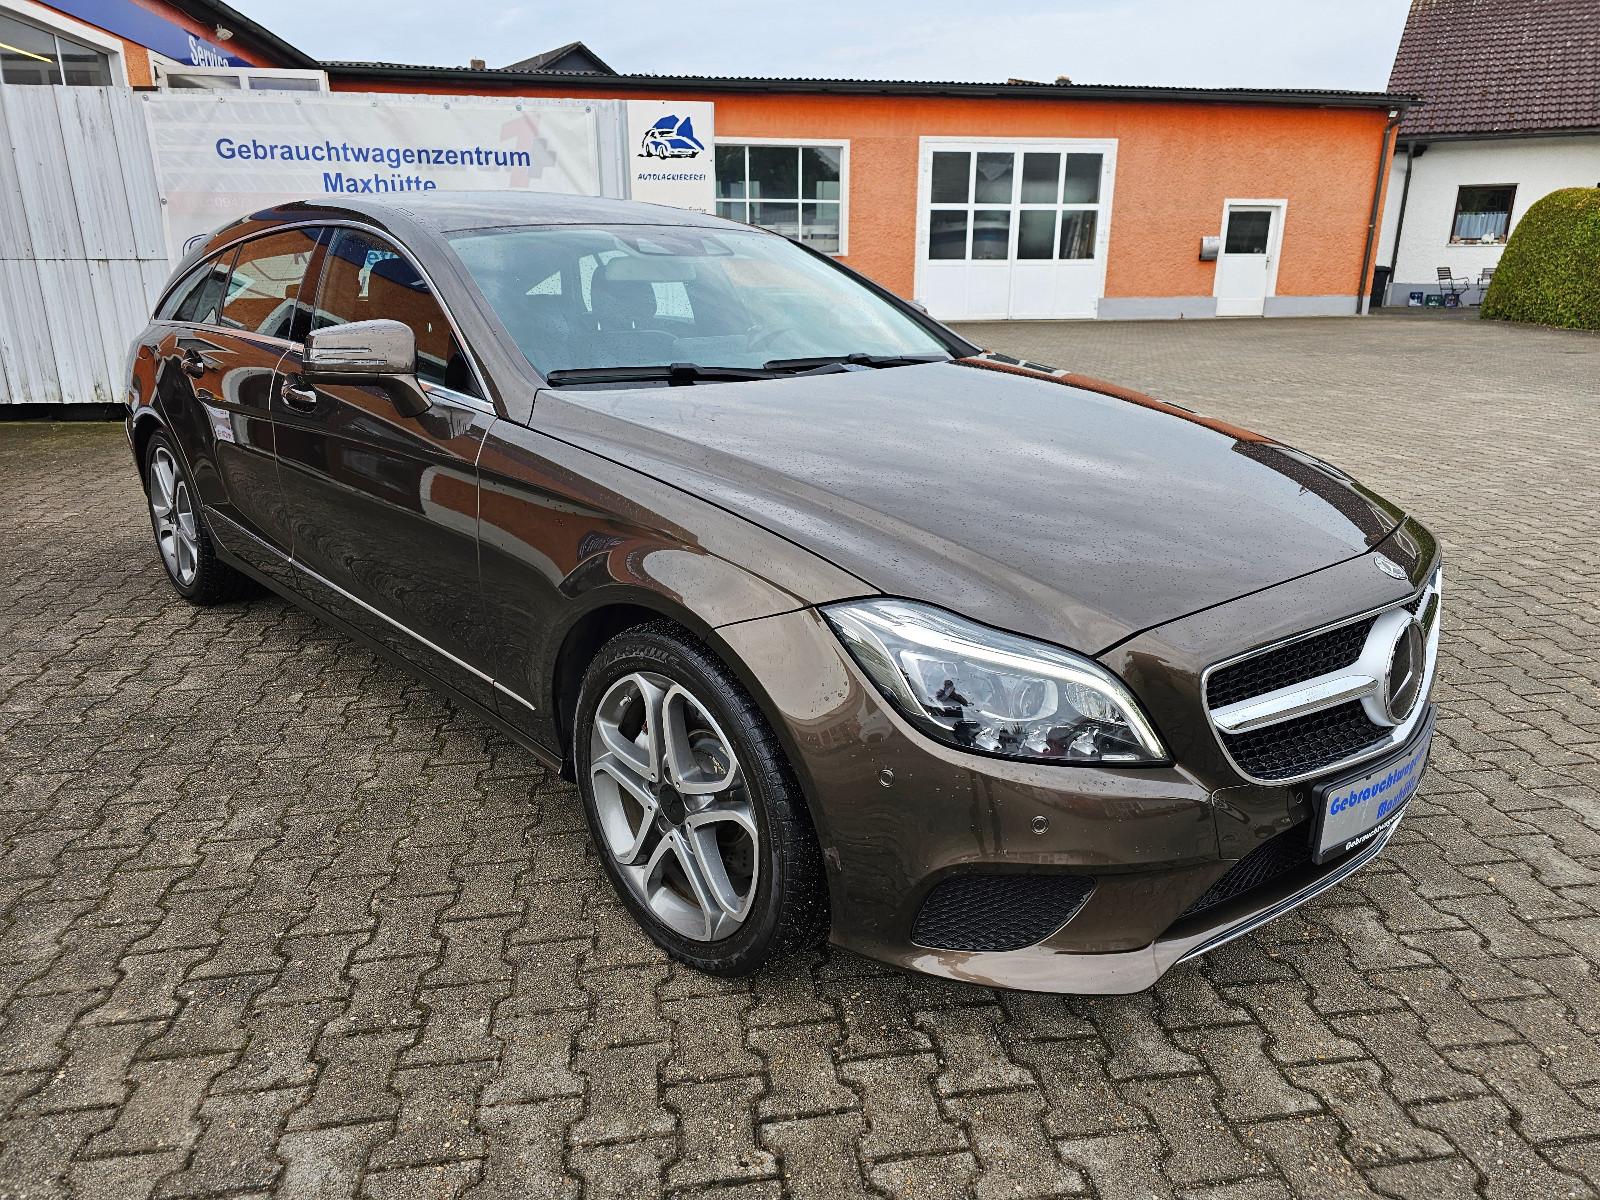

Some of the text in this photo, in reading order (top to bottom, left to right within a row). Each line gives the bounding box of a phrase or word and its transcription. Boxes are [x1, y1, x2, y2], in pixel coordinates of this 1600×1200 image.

[216, 138, 531, 169] Gebrauchtwagenzentrum
[323, 172, 437, 194] Maxhütte
[637, 172, 706, 181] AUTOLACKIEREREI
